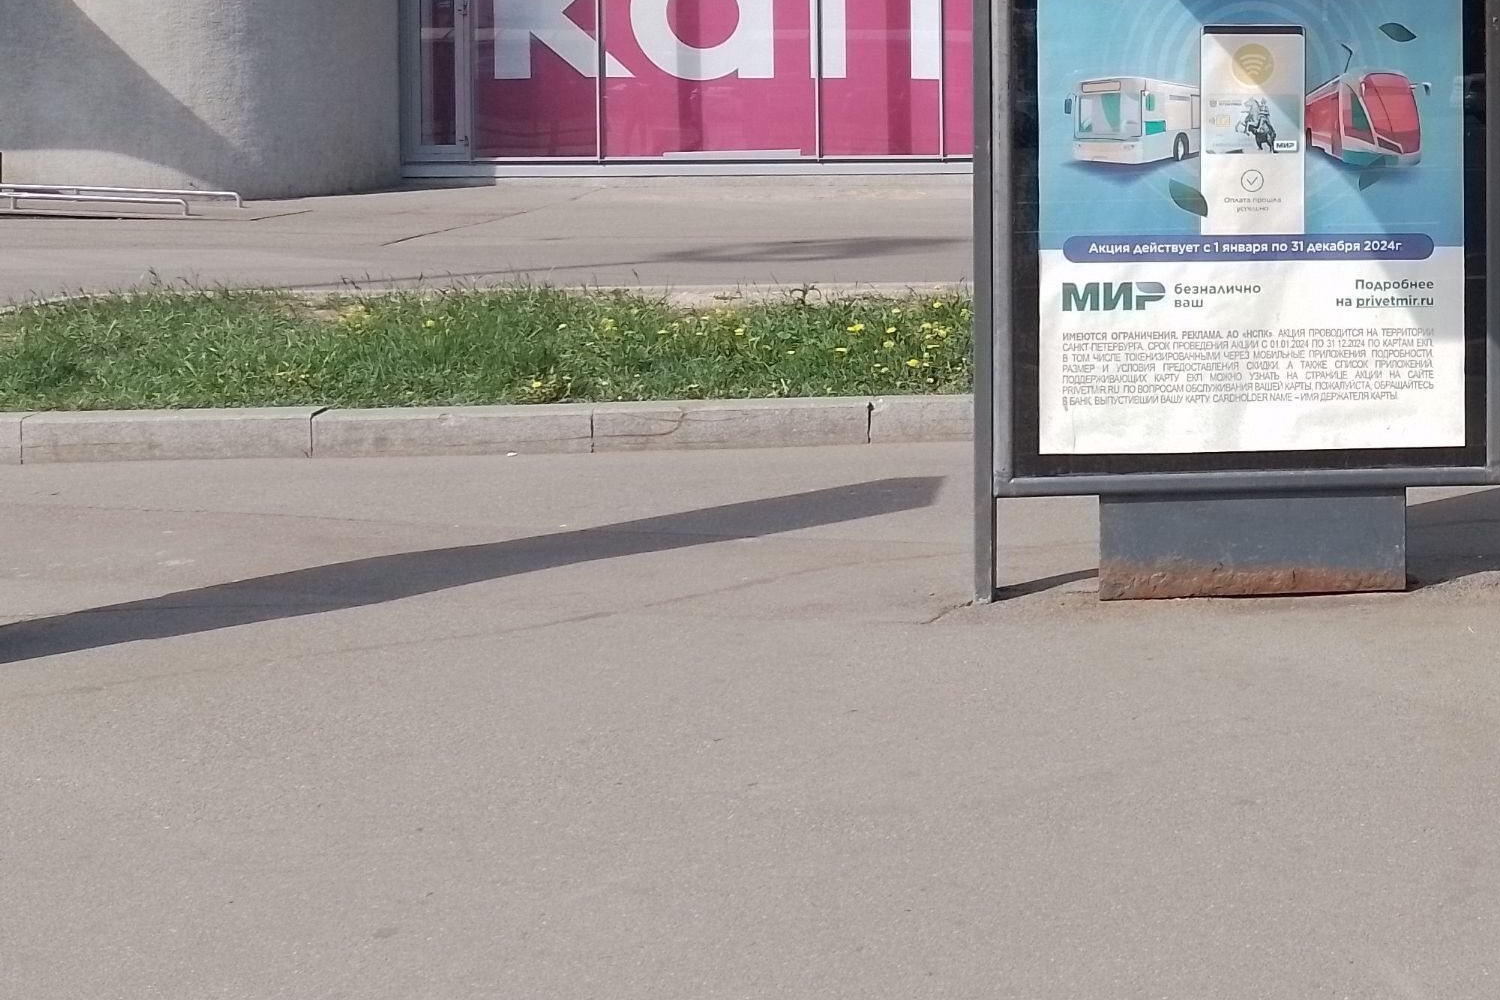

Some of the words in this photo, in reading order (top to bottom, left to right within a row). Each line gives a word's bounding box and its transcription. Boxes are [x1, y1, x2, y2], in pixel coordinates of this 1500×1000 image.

[1088, 242, 1129, 256] Акция
[1133, 242, 1199, 256] действует
[1204, 243, 1211, 253] с
[1214, 241, 1219, 253] 1
[1222, 242, 1268, 255] января
[1271, 242, 1288, 253] по
[1291, 241, 1304, 253] 31
[1306, 240, 1361, 255] декабря
[1355, 279, 1434, 292] Подробнее
[1062, 281, 1166, 312] МИР
[1174, 282, 1261, 295] безналично
[1174, 298, 1204, 308] ваш
[1336, 297, 1353, 308] на
[1356, 294, 1434, 311] privetmir.ru
[1063, 332, 1107, 341] ИМЕЮТСЯ
[1227, 329, 1238, 338] АО
[1278, 328, 1305, 339] АКЦИЯ
[1309, 328, 1363, 338] ПРОВОДИТСЯ
[1367, 328, 1378, 337] НА
[1382, 328, 1434, 337] ТЕРРИТОРИИ
[1148, 341, 1170, 350] СРОК
[1173, 341, 1228, 351] ПРОВЕДЕНИЯ
[1312, 339, 1324, 348] ПО
[1368, 339, 1380, 348] ПО
[1383, 338, 1414, 347] КАРТАМ
[1072, 354, 1090, 362] ТОМ
[1093, 353, 1121, 362] ЧИСЛЕ
[1224, 351, 1249, 360] ЧЕРЕЗ
[1253, 350, 1305, 359] МОБИЛЬНЫЕ
[1117, 363, 1155, 372] УСЛОВИЯ
[1300, 360, 1328, 369] ТАКЖЕ
[1155, 373, 1180, 382] КАРТУ
[1210, 372, 1243, 381] МОЖНО
[1249, 371, 1280, 381] УЗНАТЬ
[1287, 371, 1298, 380] НА
[1390, 369, 1401, 379] НА
[1408, 369, 1434, 379] САЙТЕ
[1138, 384, 1183, 393] ВОПРОСАМ
